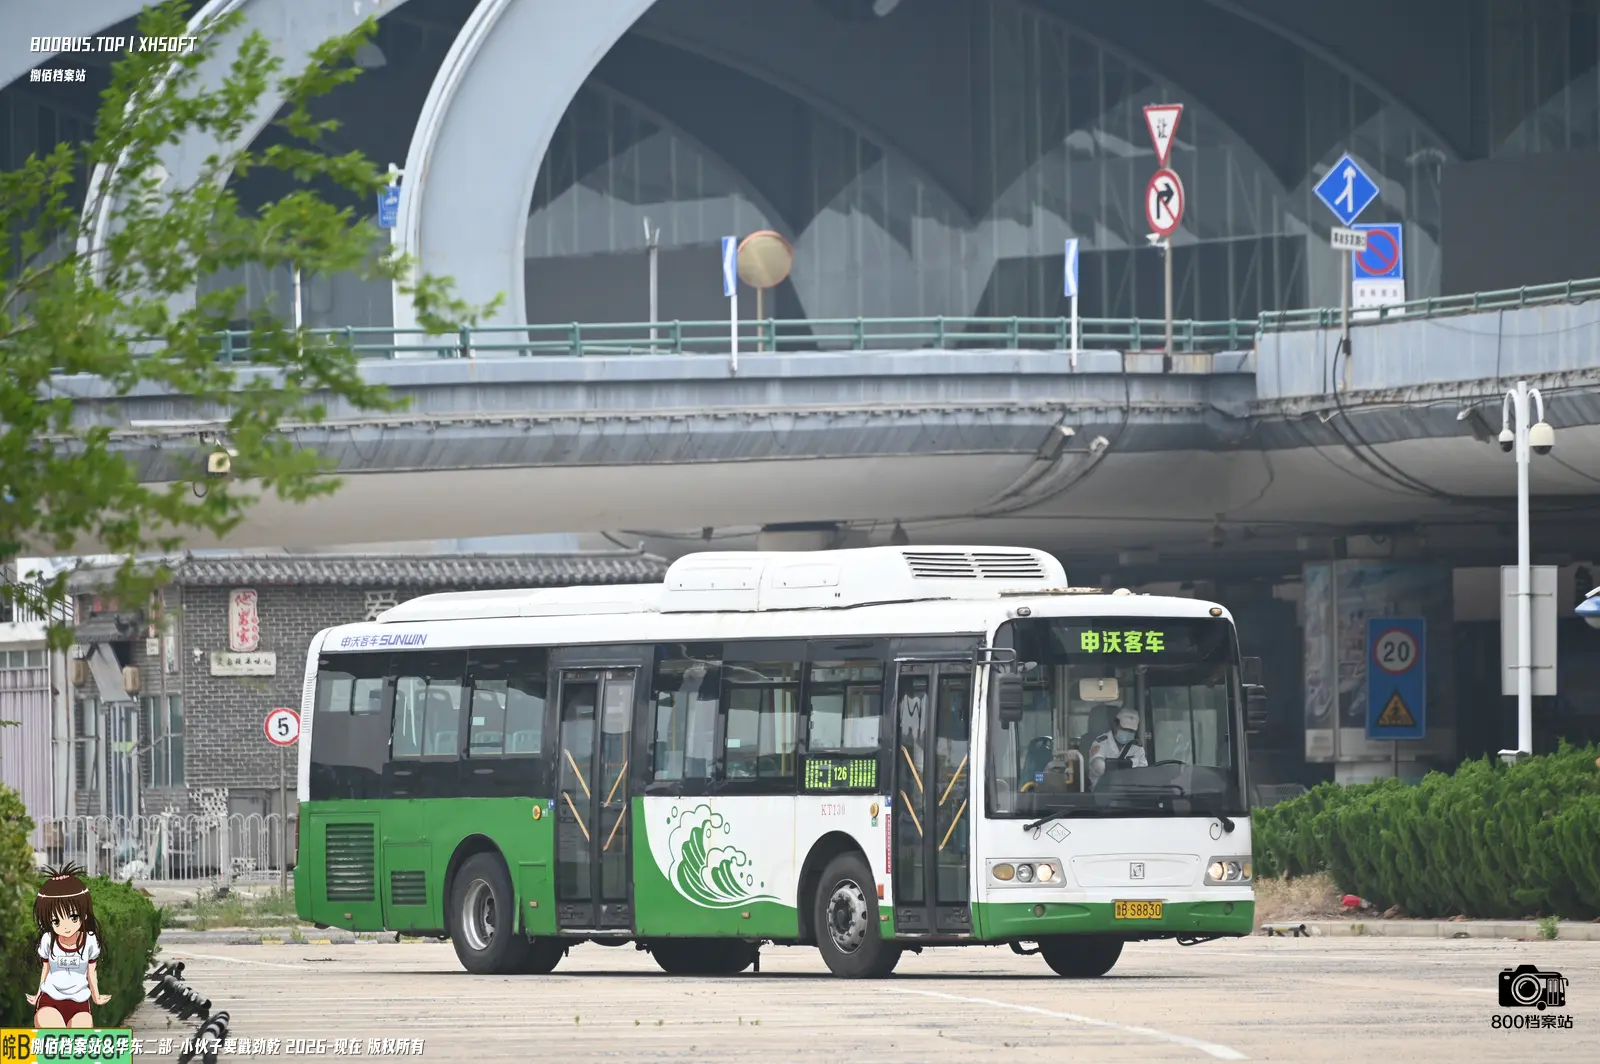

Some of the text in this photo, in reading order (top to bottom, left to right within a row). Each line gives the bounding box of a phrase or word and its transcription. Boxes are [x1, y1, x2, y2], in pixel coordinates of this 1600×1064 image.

[1156, 117, 1168, 140] 让
[340, 634, 428, 648] 申沃客车 SUNWIN
[1080, 630, 1165, 654] 申沃客车
[1383, 641, 1410, 662] 20
[277, 717, 290, 737] 5
[833, 766, 848, 781] 126
[821, 804, 846, 816] KT130
